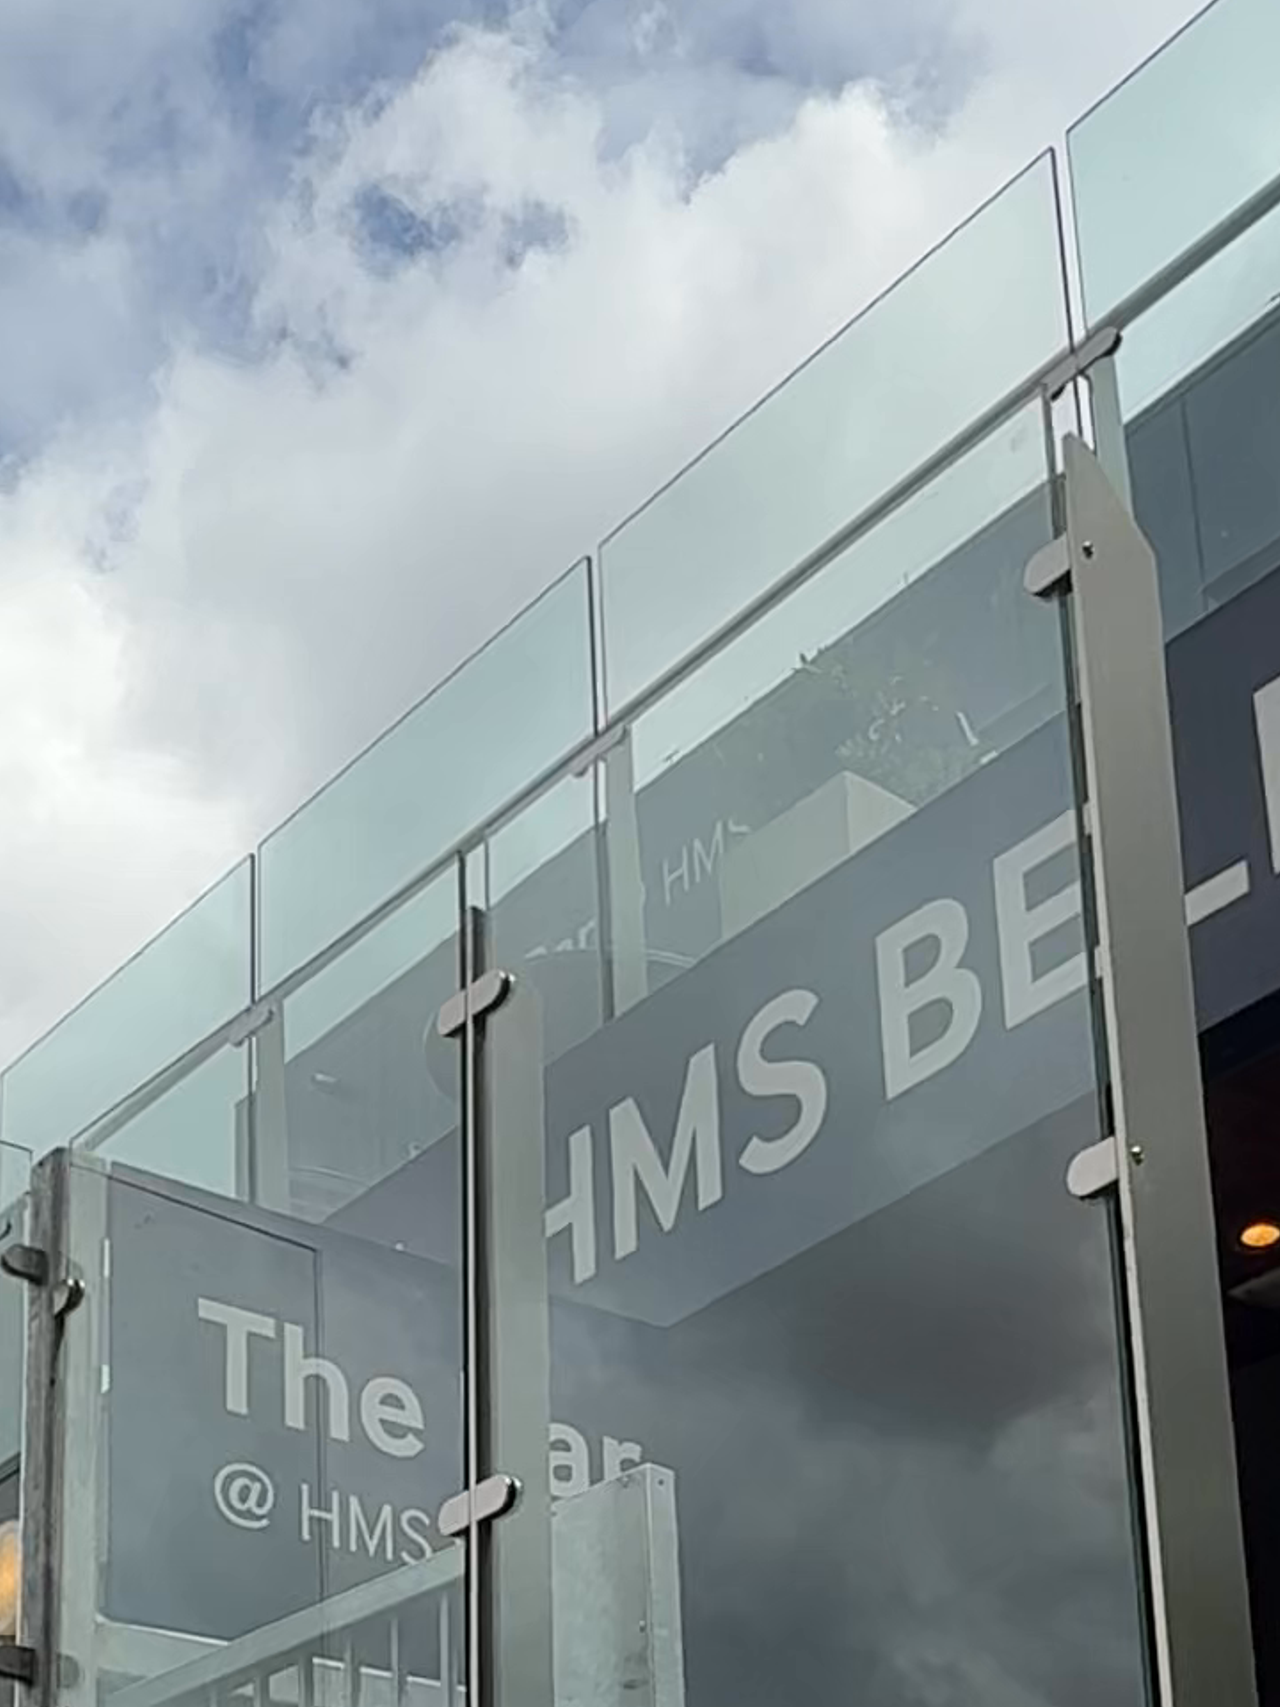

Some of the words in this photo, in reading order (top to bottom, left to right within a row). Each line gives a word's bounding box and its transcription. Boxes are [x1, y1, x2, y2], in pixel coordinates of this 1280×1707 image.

[545, 987, 829, 1286] HMS
[197, 1297, 426, 1458] The
[213, 1461, 275, 1529] @
[299, 1482, 433, 1566] HMS
